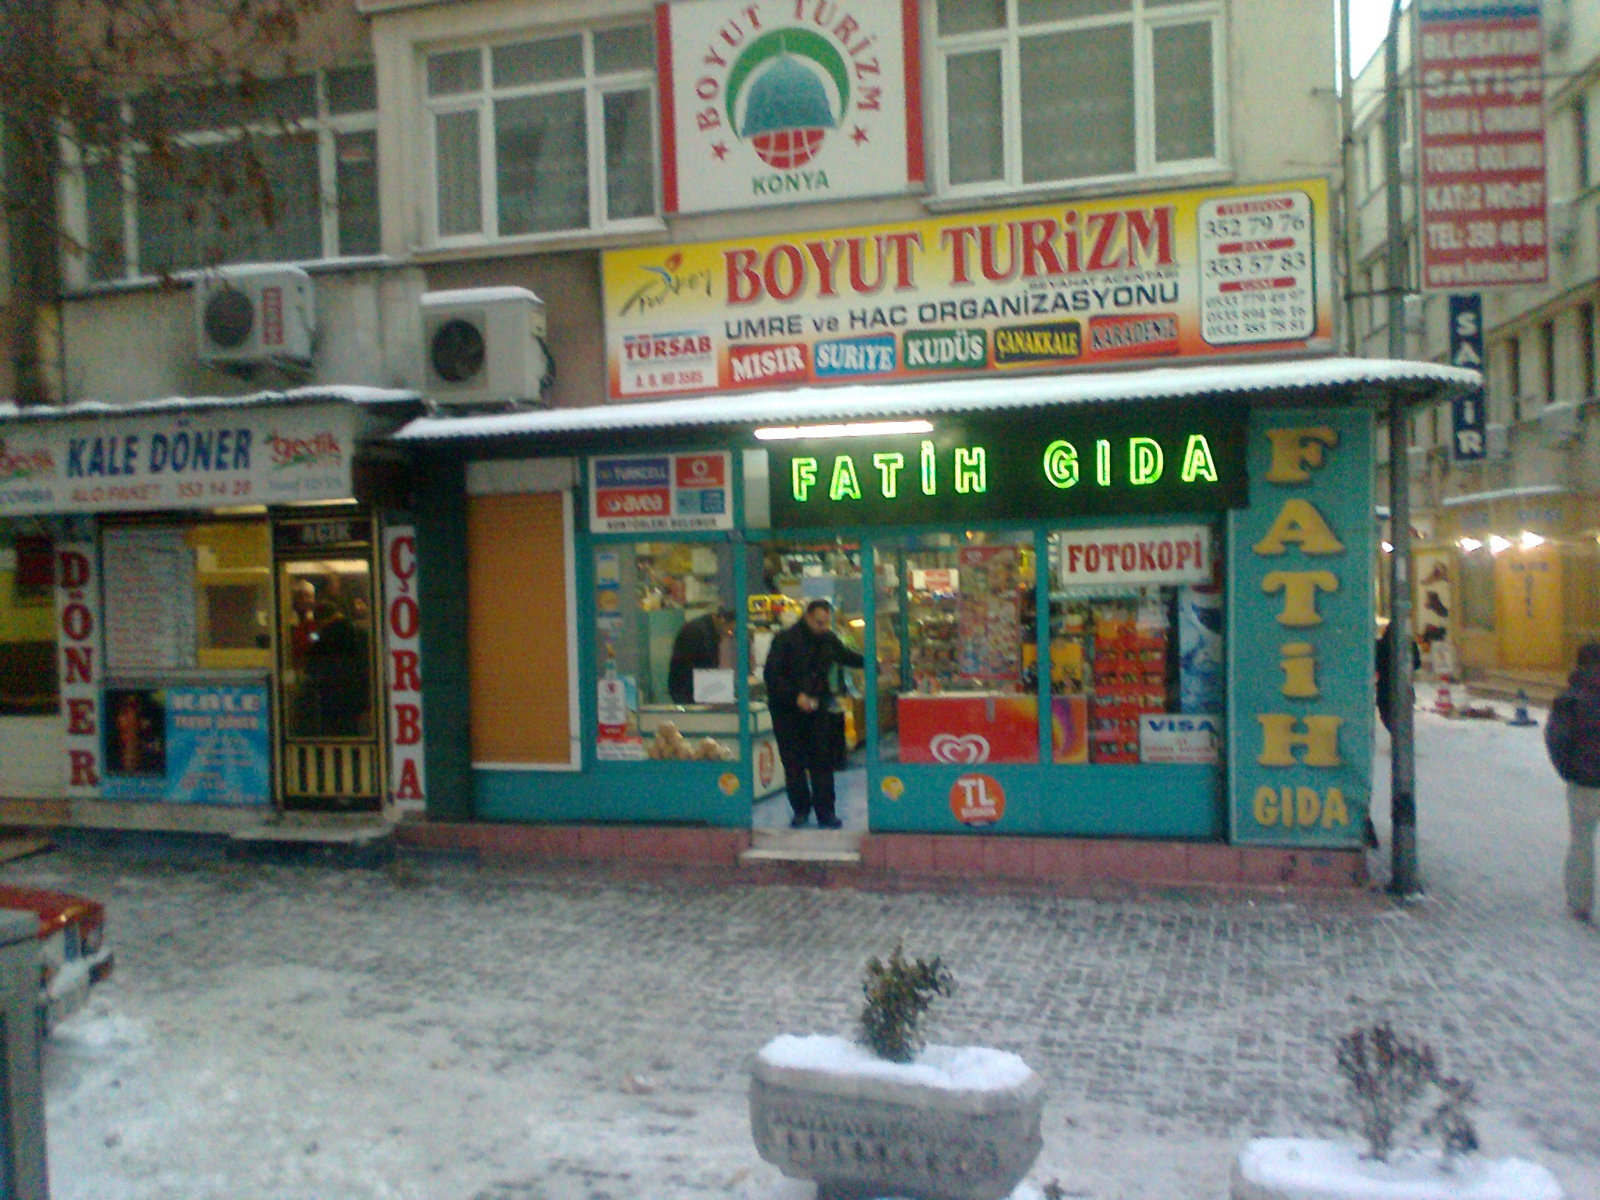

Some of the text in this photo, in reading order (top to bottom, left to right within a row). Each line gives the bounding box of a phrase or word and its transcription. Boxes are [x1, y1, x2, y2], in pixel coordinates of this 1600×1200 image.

[696, 4, 763, 132] BOYUT
[752, 170, 830, 195] KONYA
[722, 231, 922, 306] BOYUT
[725, 280, 1181, 341] UMRE ve HAC ORGANİZASYONU
[623, 333, 713, 360] TÜRSAB
[729, 345, 806, 383] MISIR
[907, 328, 985, 367] KUDÜS
[1455, 311, 1484, 456] SAIR
[67, 418, 253, 479] KALE DÖNER
[790, 434, 1219, 502] FATİH GIDA
[1067, 533, 1204, 574] FOTOKOPİ
[60, 551, 99, 788] DÖNER
[389, 536, 425, 801] ÇORBA
[1148, 719, 1217, 735] VISA
[957, 777, 997, 807] TL
[1252, 785, 1350, 830] GIDA
